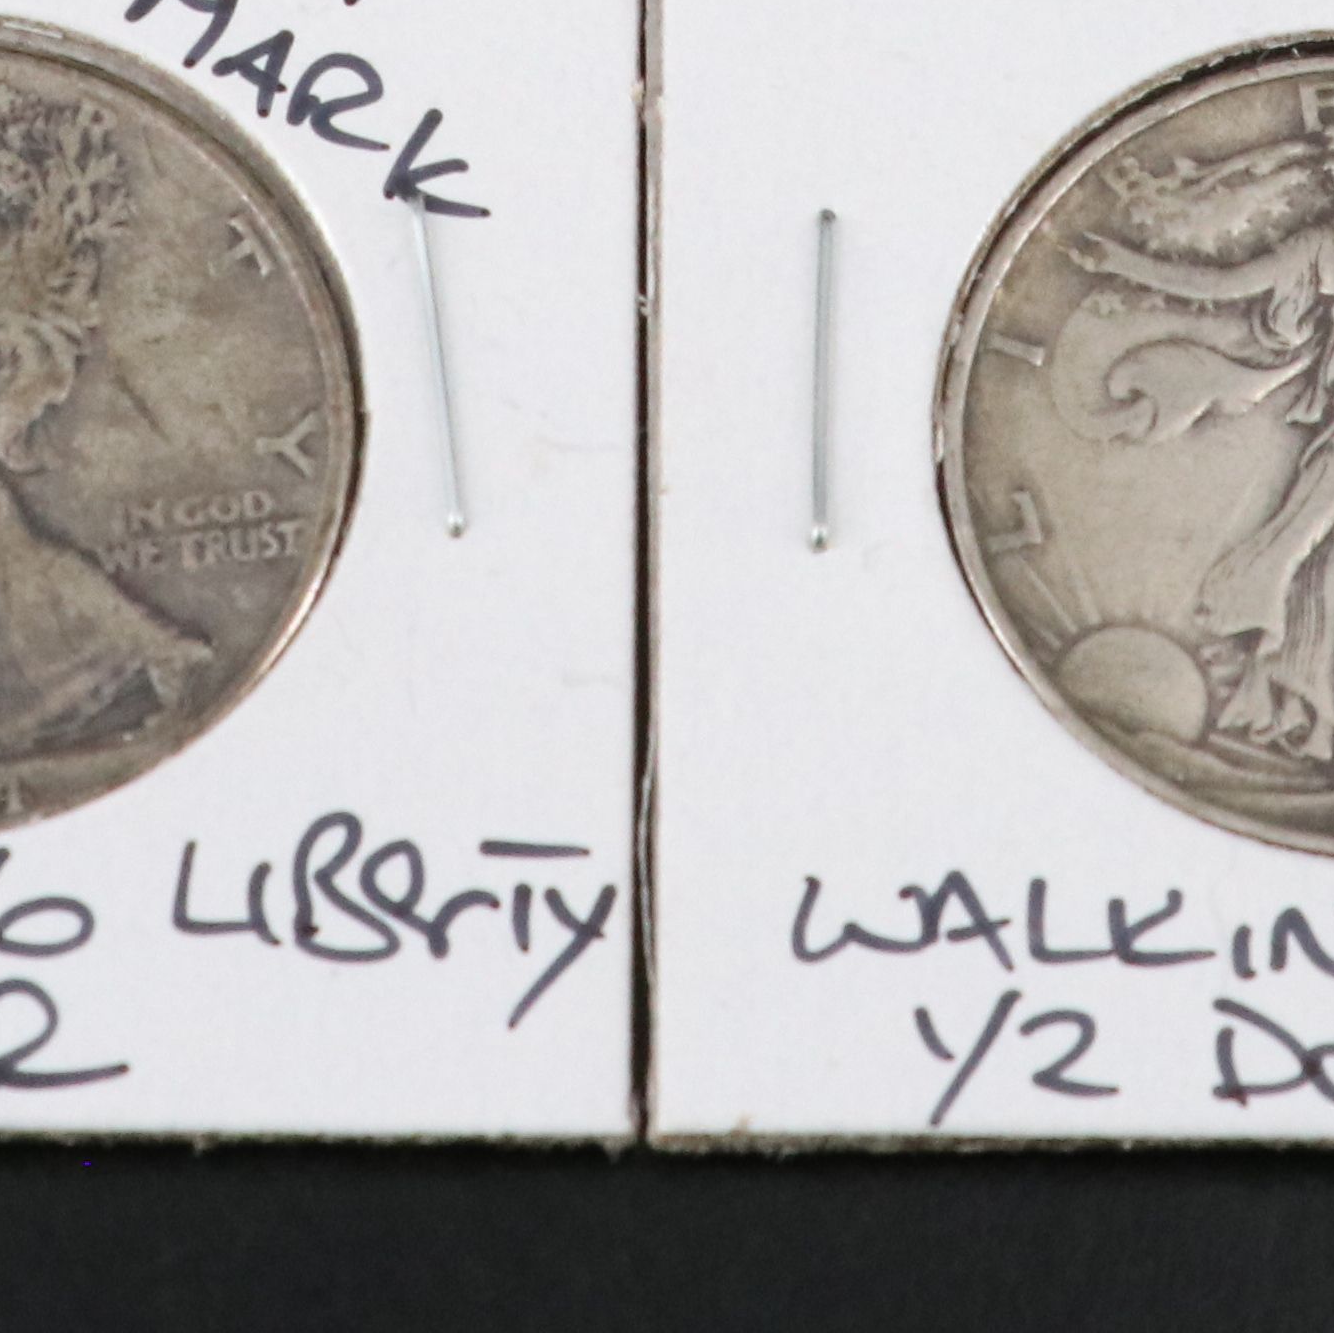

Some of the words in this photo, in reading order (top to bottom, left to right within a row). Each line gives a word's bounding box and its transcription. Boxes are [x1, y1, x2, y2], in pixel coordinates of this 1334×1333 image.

[113, 498, 165, 535] IN
[173, 490, 274, 526] GOD
[171, 519, 304, 570] TRUST
[914, 989, 1119, 1127] 1/2
